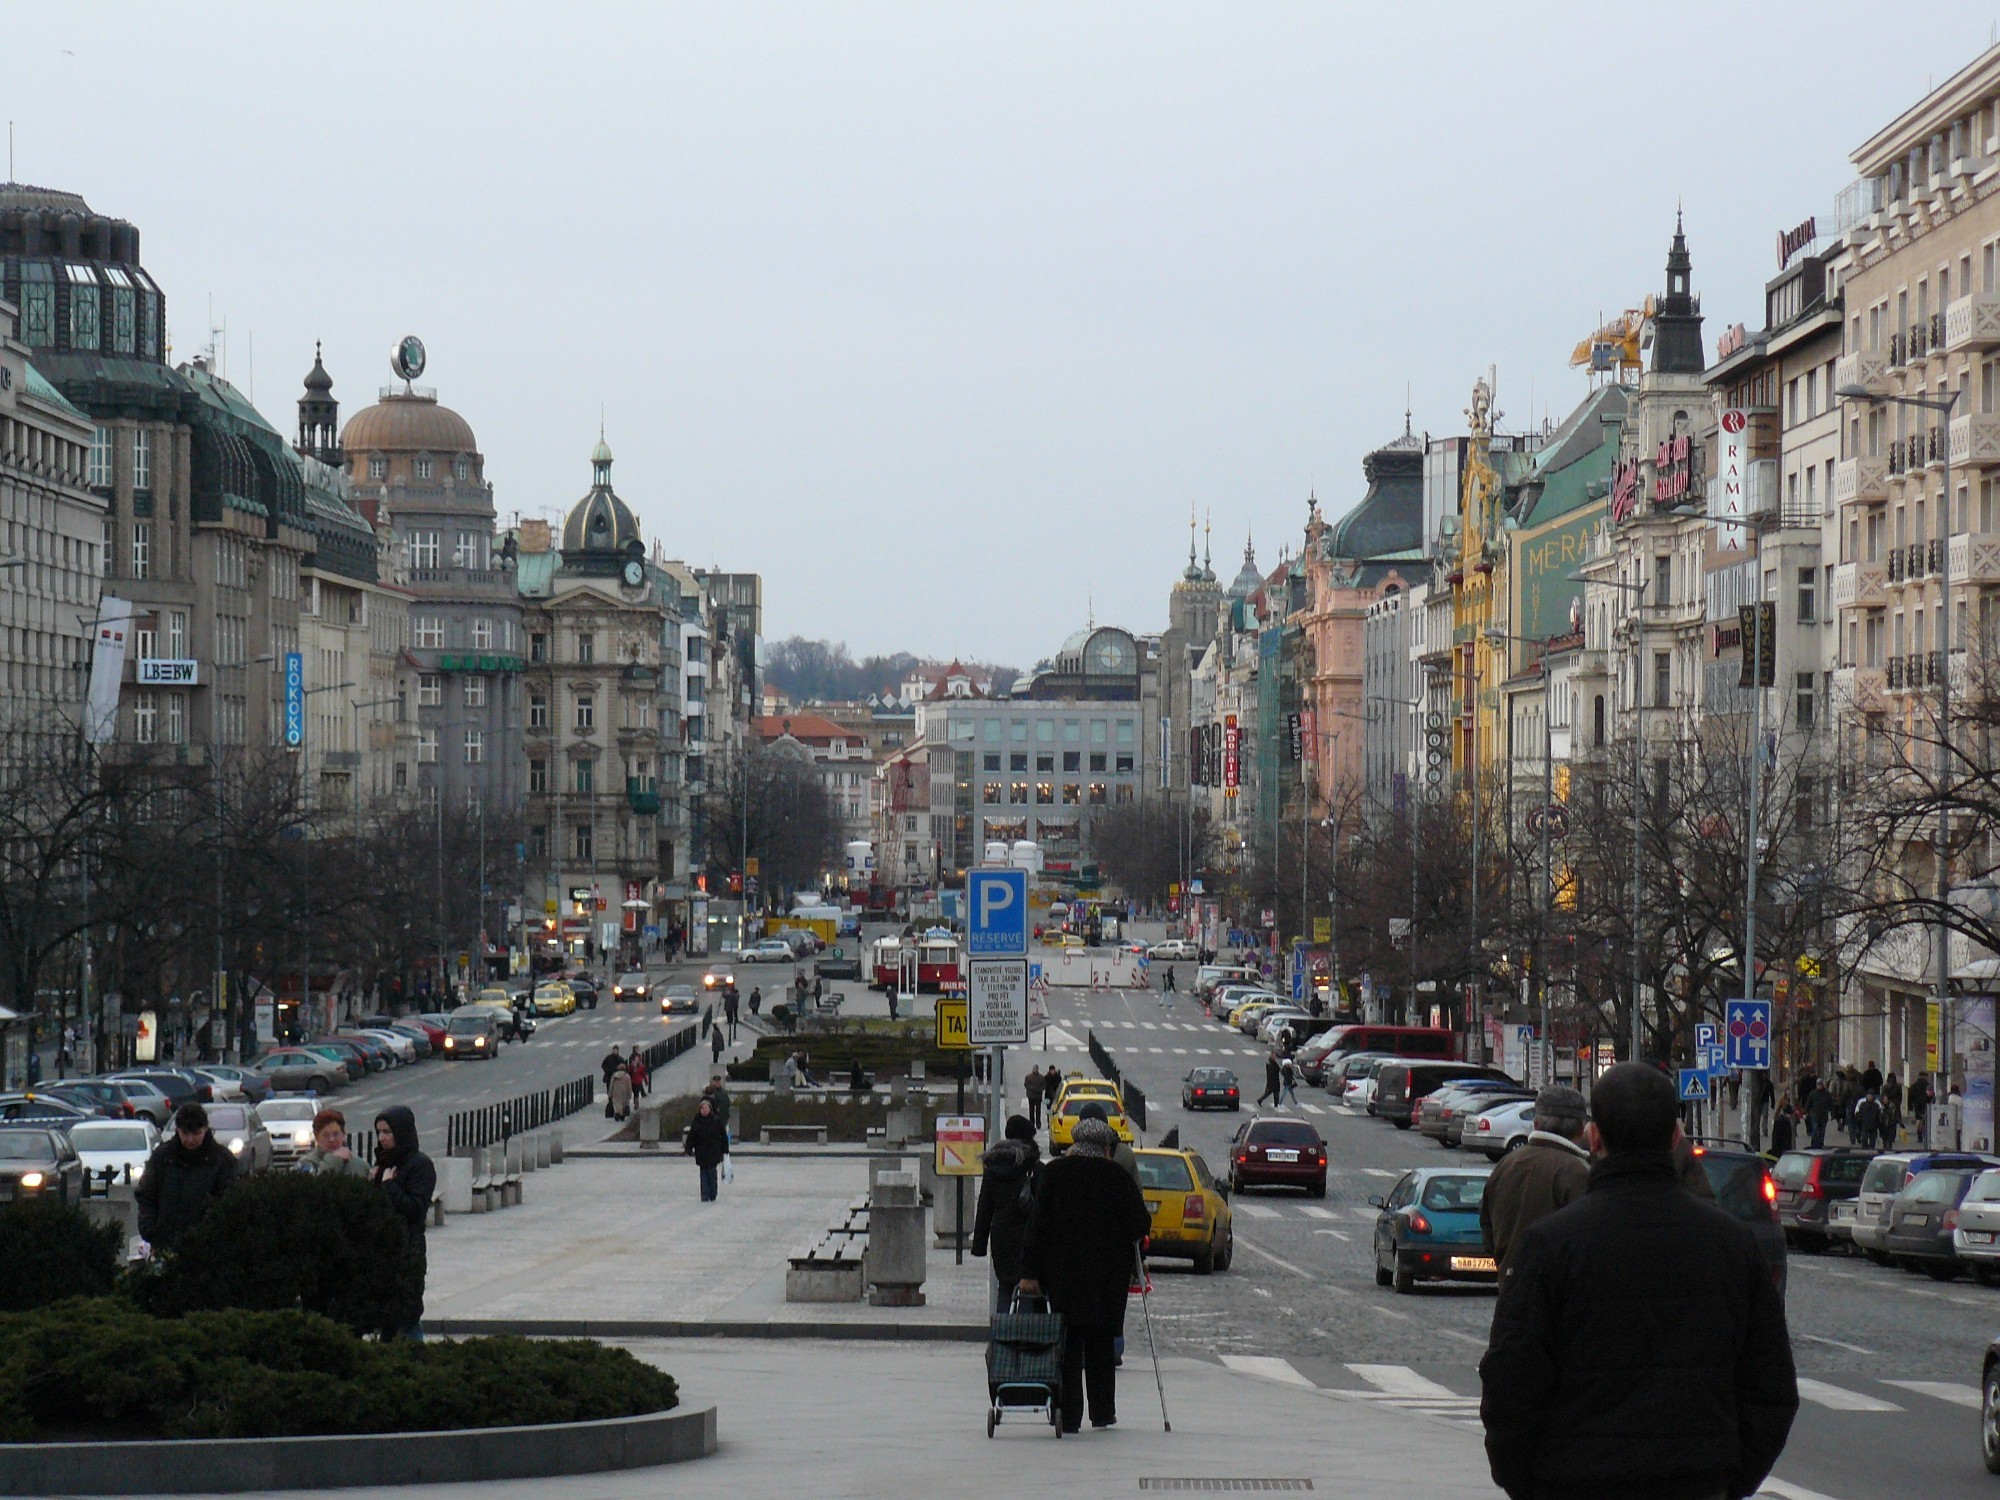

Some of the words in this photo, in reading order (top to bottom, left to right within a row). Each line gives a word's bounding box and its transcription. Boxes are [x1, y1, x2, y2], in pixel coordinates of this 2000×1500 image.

[288, 658, 300, 745] ROKOKO
[981, 880, 1013, 928] P
[1001, 1001, 1012, 1009] TAXI
[1700, 1027, 1712, 1046] P
[1711, 1048, 1724, 1067] P
